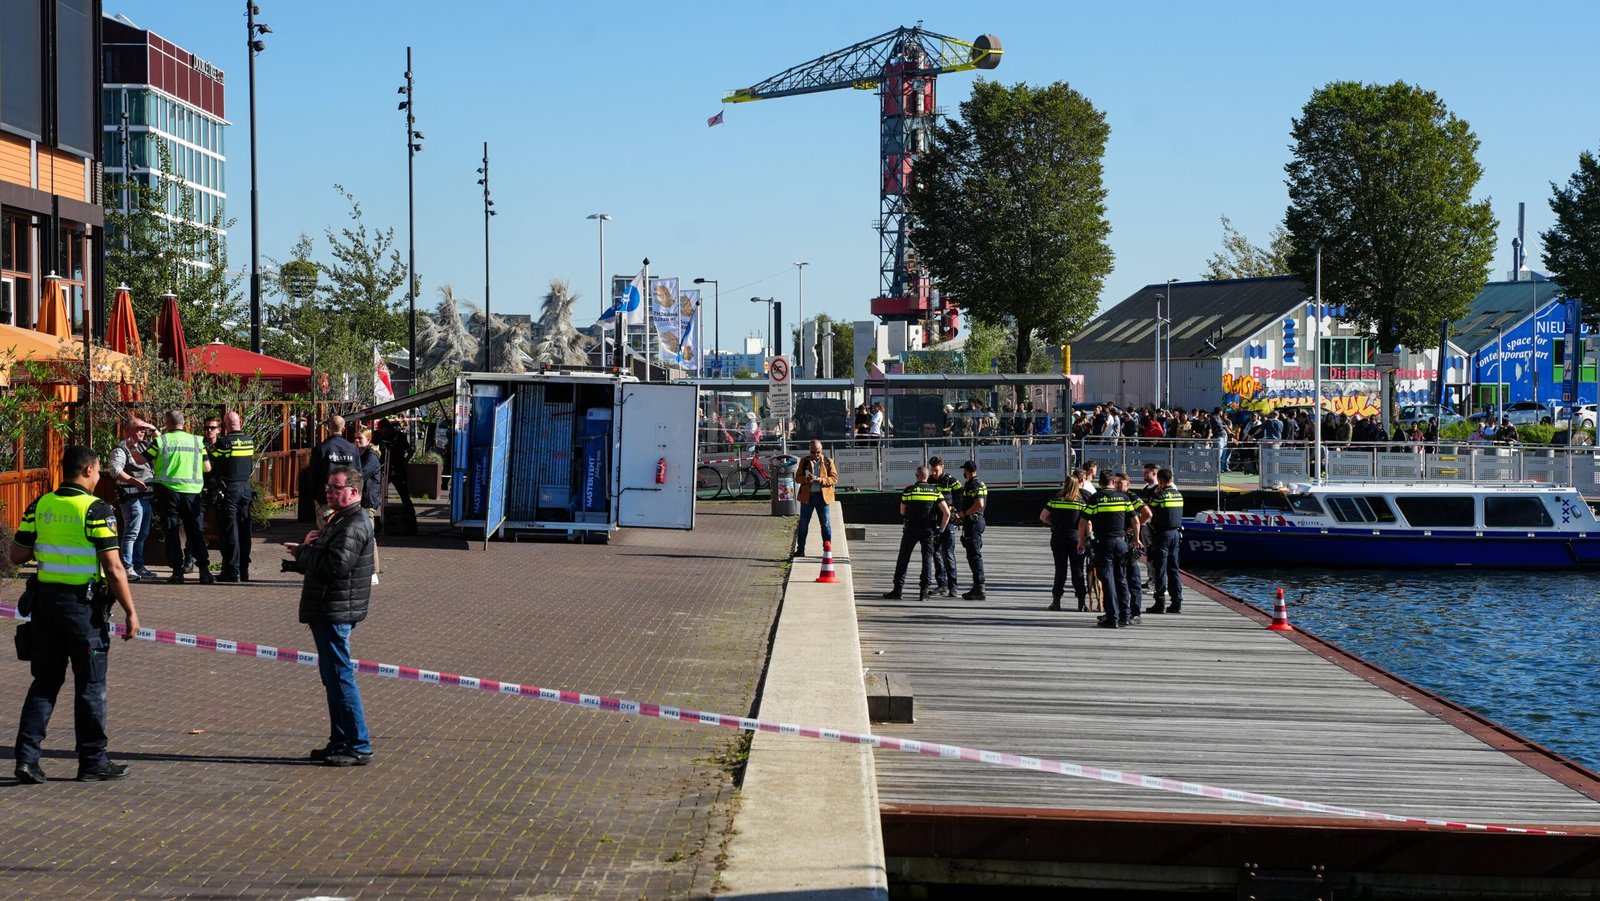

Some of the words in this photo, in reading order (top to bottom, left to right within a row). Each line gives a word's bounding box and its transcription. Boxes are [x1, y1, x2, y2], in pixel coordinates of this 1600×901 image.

[1537, 321, 1565, 333] NIEU
[1506, 337, 1531, 350] space
[1535, 335, 1548, 345] for
[1476, 350, 1533, 368] contemporary
[1536, 350, 1548, 360] art
[1252, 366, 1314, 380] Beautiful
[1396, 368, 1438, 379] House
[329, 452, 353, 461] POLITIE
[586, 456, 595, 507] MASTERTENT
[38, 507, 80, 524] POLITIE
[1189, 540, 1228, 552] P55
